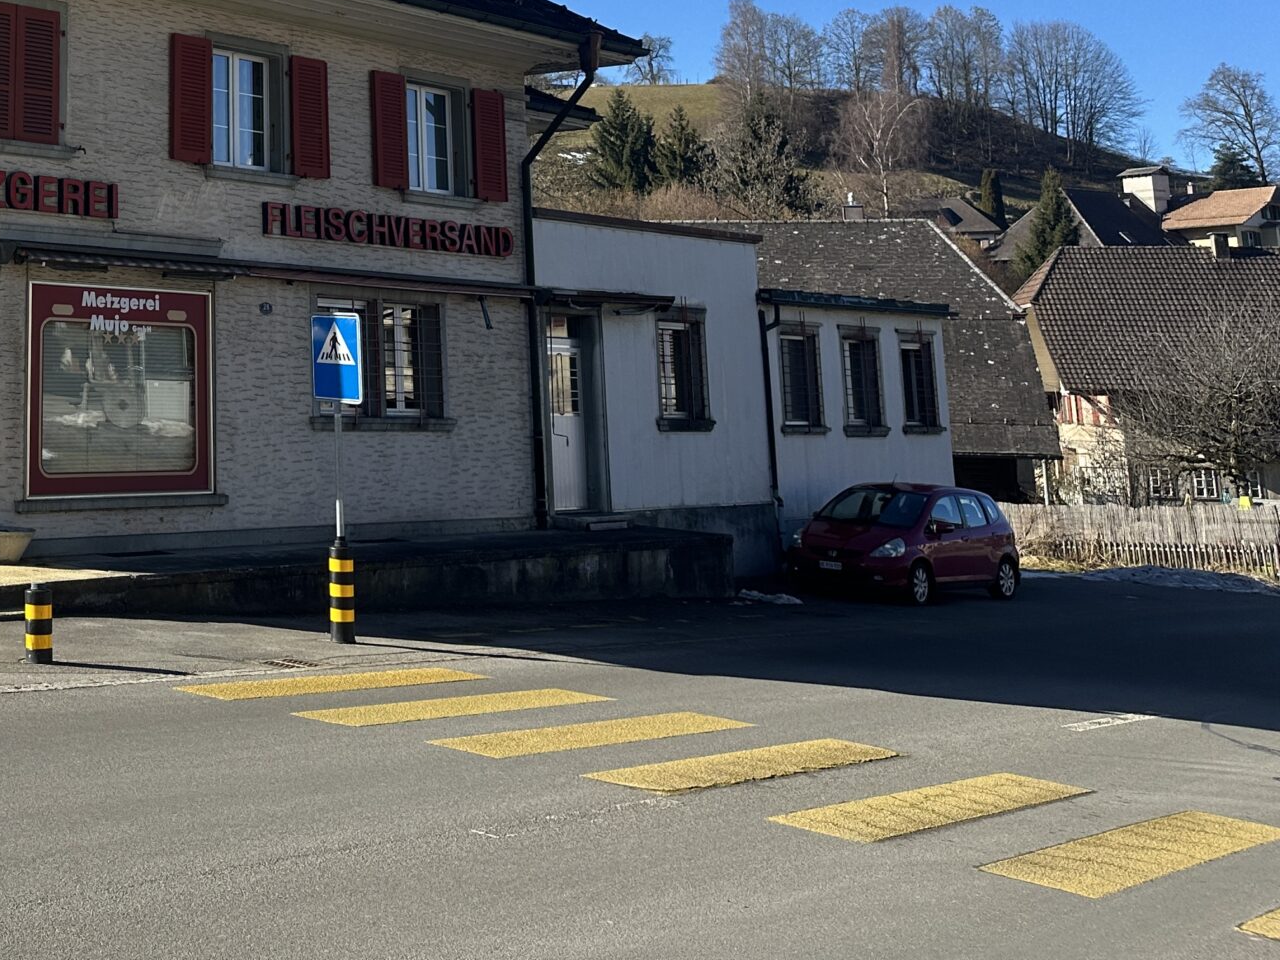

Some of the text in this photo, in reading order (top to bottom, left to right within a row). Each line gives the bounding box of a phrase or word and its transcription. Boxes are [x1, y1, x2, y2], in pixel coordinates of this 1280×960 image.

[262, 201, 514, 257] FLEISCHVERSAND
[81, 290, 160, 313] Metzgerei
[90, 314, 152, 336] Mujo GmbH
